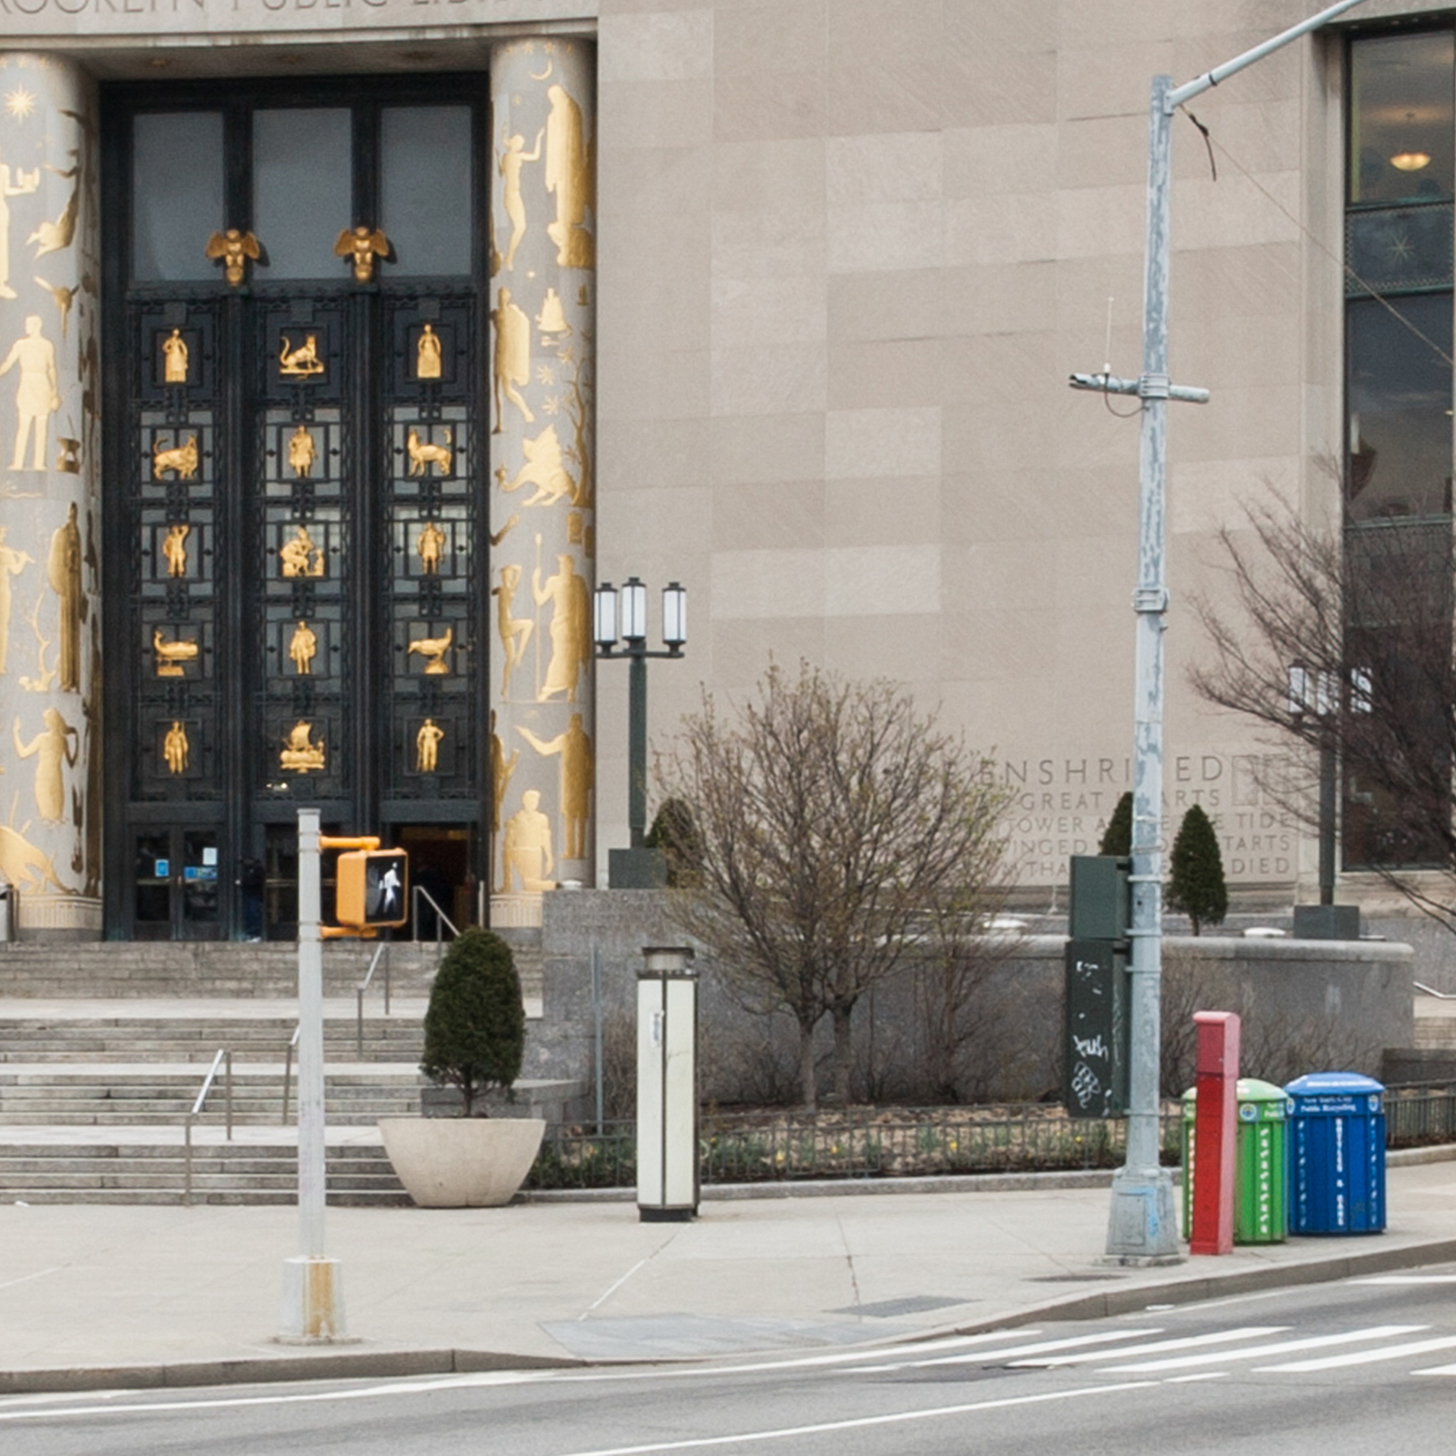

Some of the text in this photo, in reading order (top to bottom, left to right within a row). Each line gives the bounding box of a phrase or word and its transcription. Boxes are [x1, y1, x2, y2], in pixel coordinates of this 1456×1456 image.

[980, 755, 1224, 785] ENSHRIED
[1019, 791, 1104, 811] GREAT
[1236, 812, 1290, 829] TIDE
[1222, 835, 1290, 852] TARTS
[1231, 857, 1291, 875] DIED
